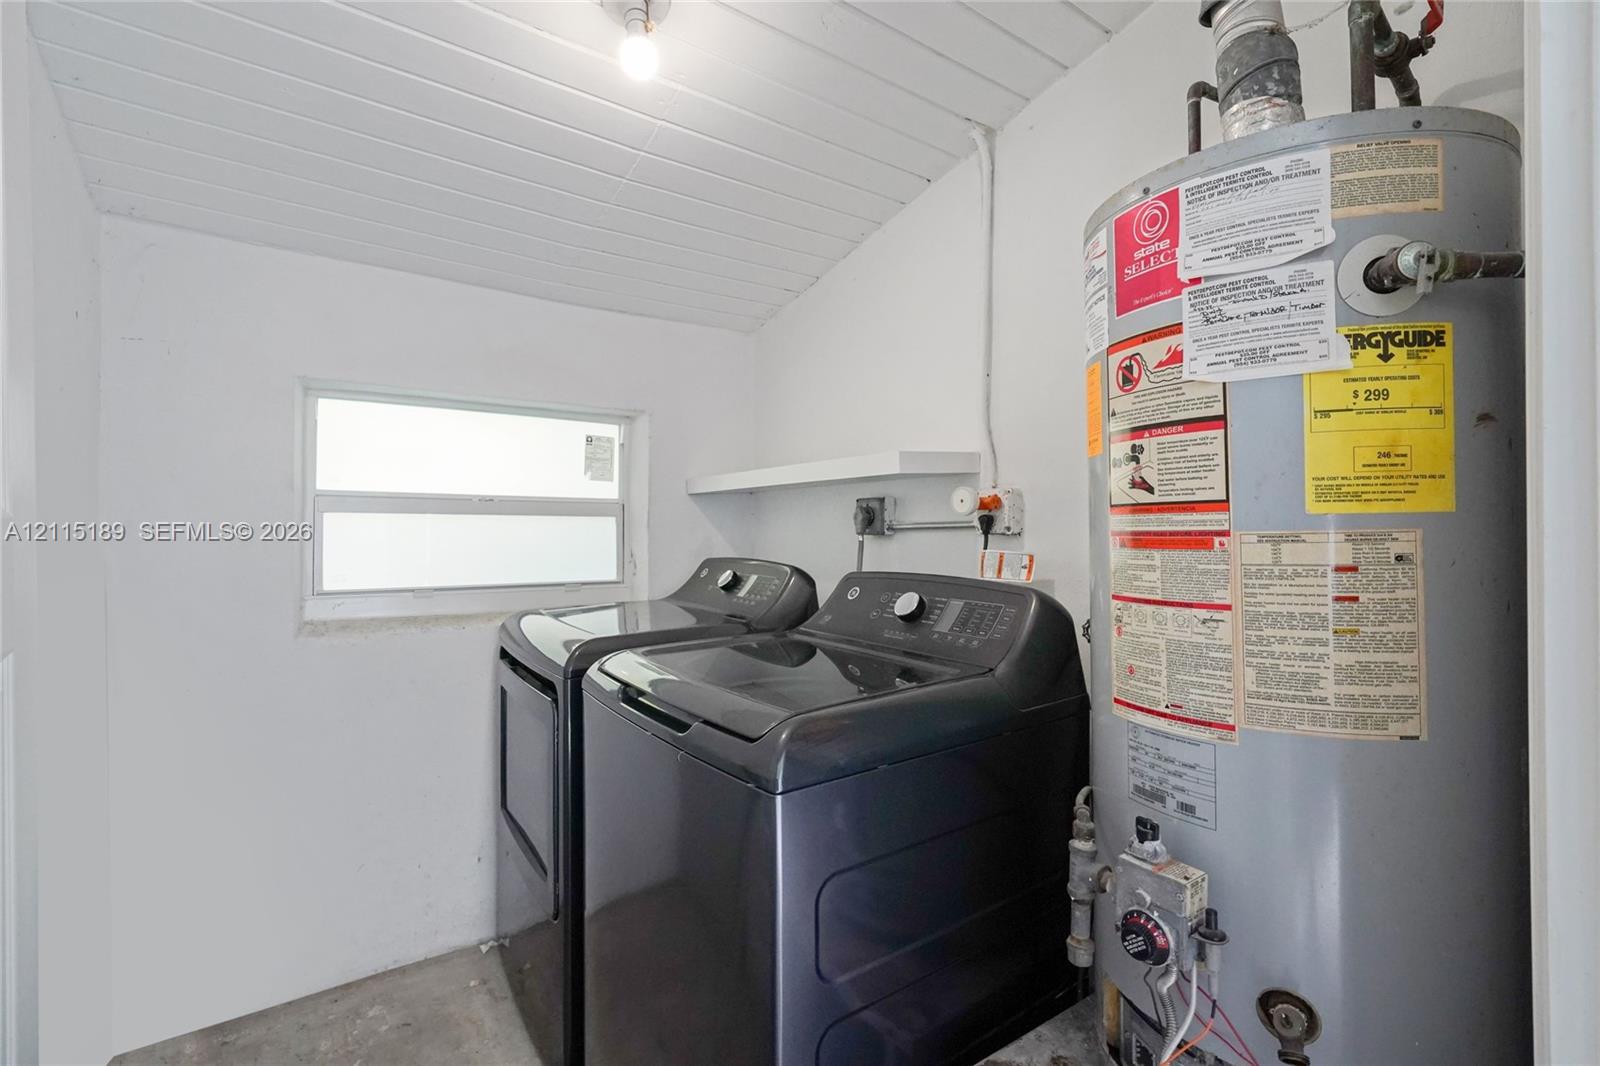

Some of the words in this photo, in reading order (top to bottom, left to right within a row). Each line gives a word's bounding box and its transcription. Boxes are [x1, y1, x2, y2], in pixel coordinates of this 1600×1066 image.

[1185, 178, 1224, 193] PESTDEPOT.COM
[1225, 172, 1239, 181] PEST
[1239, 166, 1266, 178] CONTROL
[1187, 193, 1206, 206] NOTICE
[1208, 191, 1215, 199] OF
[1217, 182, 1253, 197] INSPECTION
[1254, 175, 1280, 189] AND/OR
[1281, 168, 1321, 181] TREATMENT
[1189, 183, 1222, 198] INTELLIGENT
[1222, 178, 1245, 188] TERMITE
[1246, 170, 1273, 181] CONTROL
[1226, 222, 1246, 231] CONTROL
[1133, 239, 1170, 261] state
[1202, 254, 1223, 262] ANNUAL
[1238, 246, 1267, 255] CONTROL
[1267, 239, 1304, 249] AGREEMENT
[1211, 239, 1253, 252] PESTDEPOT.COM
[1254, 236, 1268, 244] PEST
[1270, 232, 1296, 240] CONTROL
[1187, 282, 1228, 296] PESTDEPOT.COM
[1228, 279, 1242, 287] PEST
[1242, 275, 1269, 284] CONTROL
[1189, 299, 1210, 308] NOTICE
[1220, 290, 1257, 302] INSPECTION
[1257, 285, 1284, 297] AND/OR
[1285, 279, 1325, 290] TREATMENT
[1192, 289, 1225, 300] INTELLIGENT
[1226, 284, 1249, 293] TERMITE
[1250, 279, 1277, 288] CONTROL
[1230, 329, 1250, 337] CONTROL
[1251, 325, 1280, 334] SPECIALISTS
[1302, 319, 1324, 327] EXPERTS
[1206, 359, 1228, 367] ANNUAL
[1228, 357, 1242, 365] PEST
[1243, 353, 1271, 362] CONTROL
[1272, 349, 1309, 359] AGREEMENT
[1215, 347, 1258, 358] PESTDEPOT.COM
[1274, 342, 1301, 350] CONTROL
[1352, 389, 1359, 400] $
[1364, 388, 1390, 402] 299
[1152, 425, 1184, 436] DANGER
[1377, 451, 1391, 459] 246
